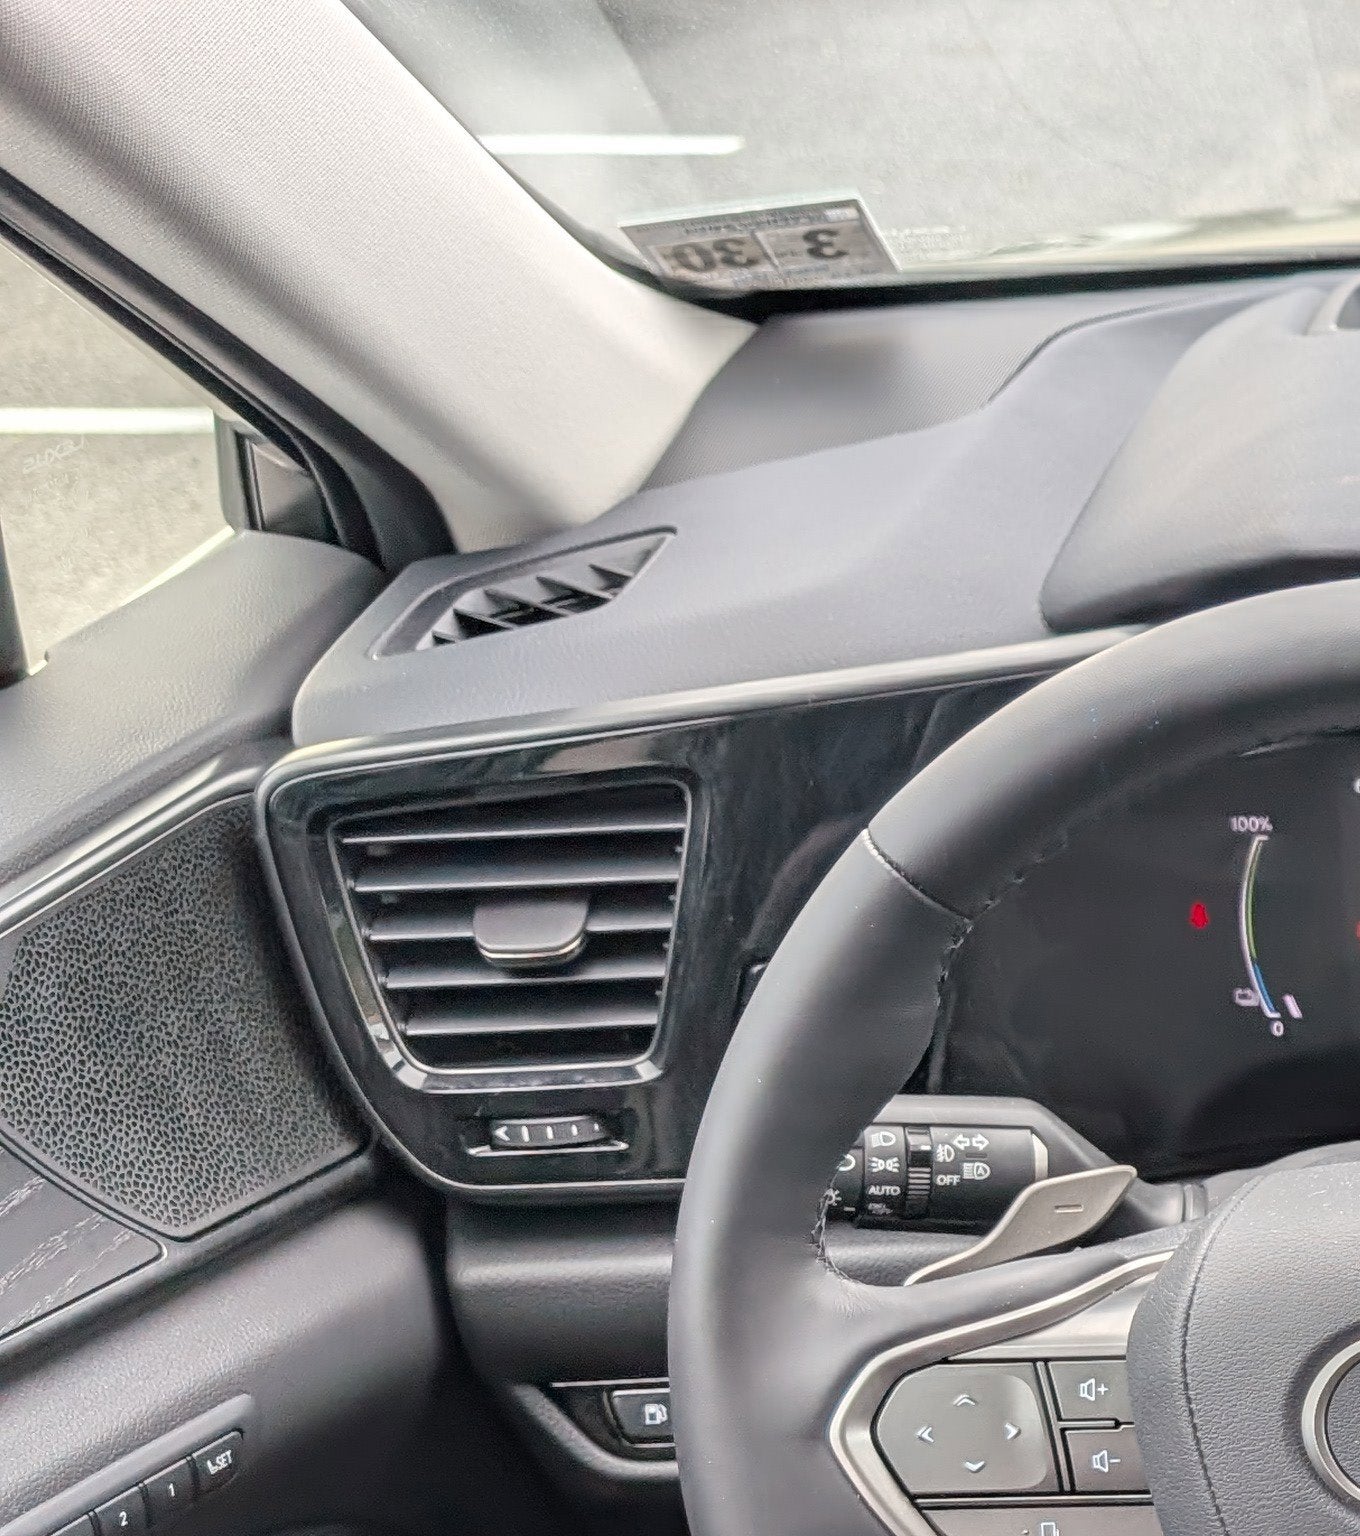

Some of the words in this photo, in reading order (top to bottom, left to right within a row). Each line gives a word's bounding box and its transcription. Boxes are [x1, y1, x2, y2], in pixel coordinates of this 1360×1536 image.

[1230, 816, 1274, 833] 100%
[935, 1174, 961, 1186] OFF
[868, 1185, 901, 1196] AUTO
[168, 1483, 176, 1497] 1
[119, 1511, 129, 1527] 2
